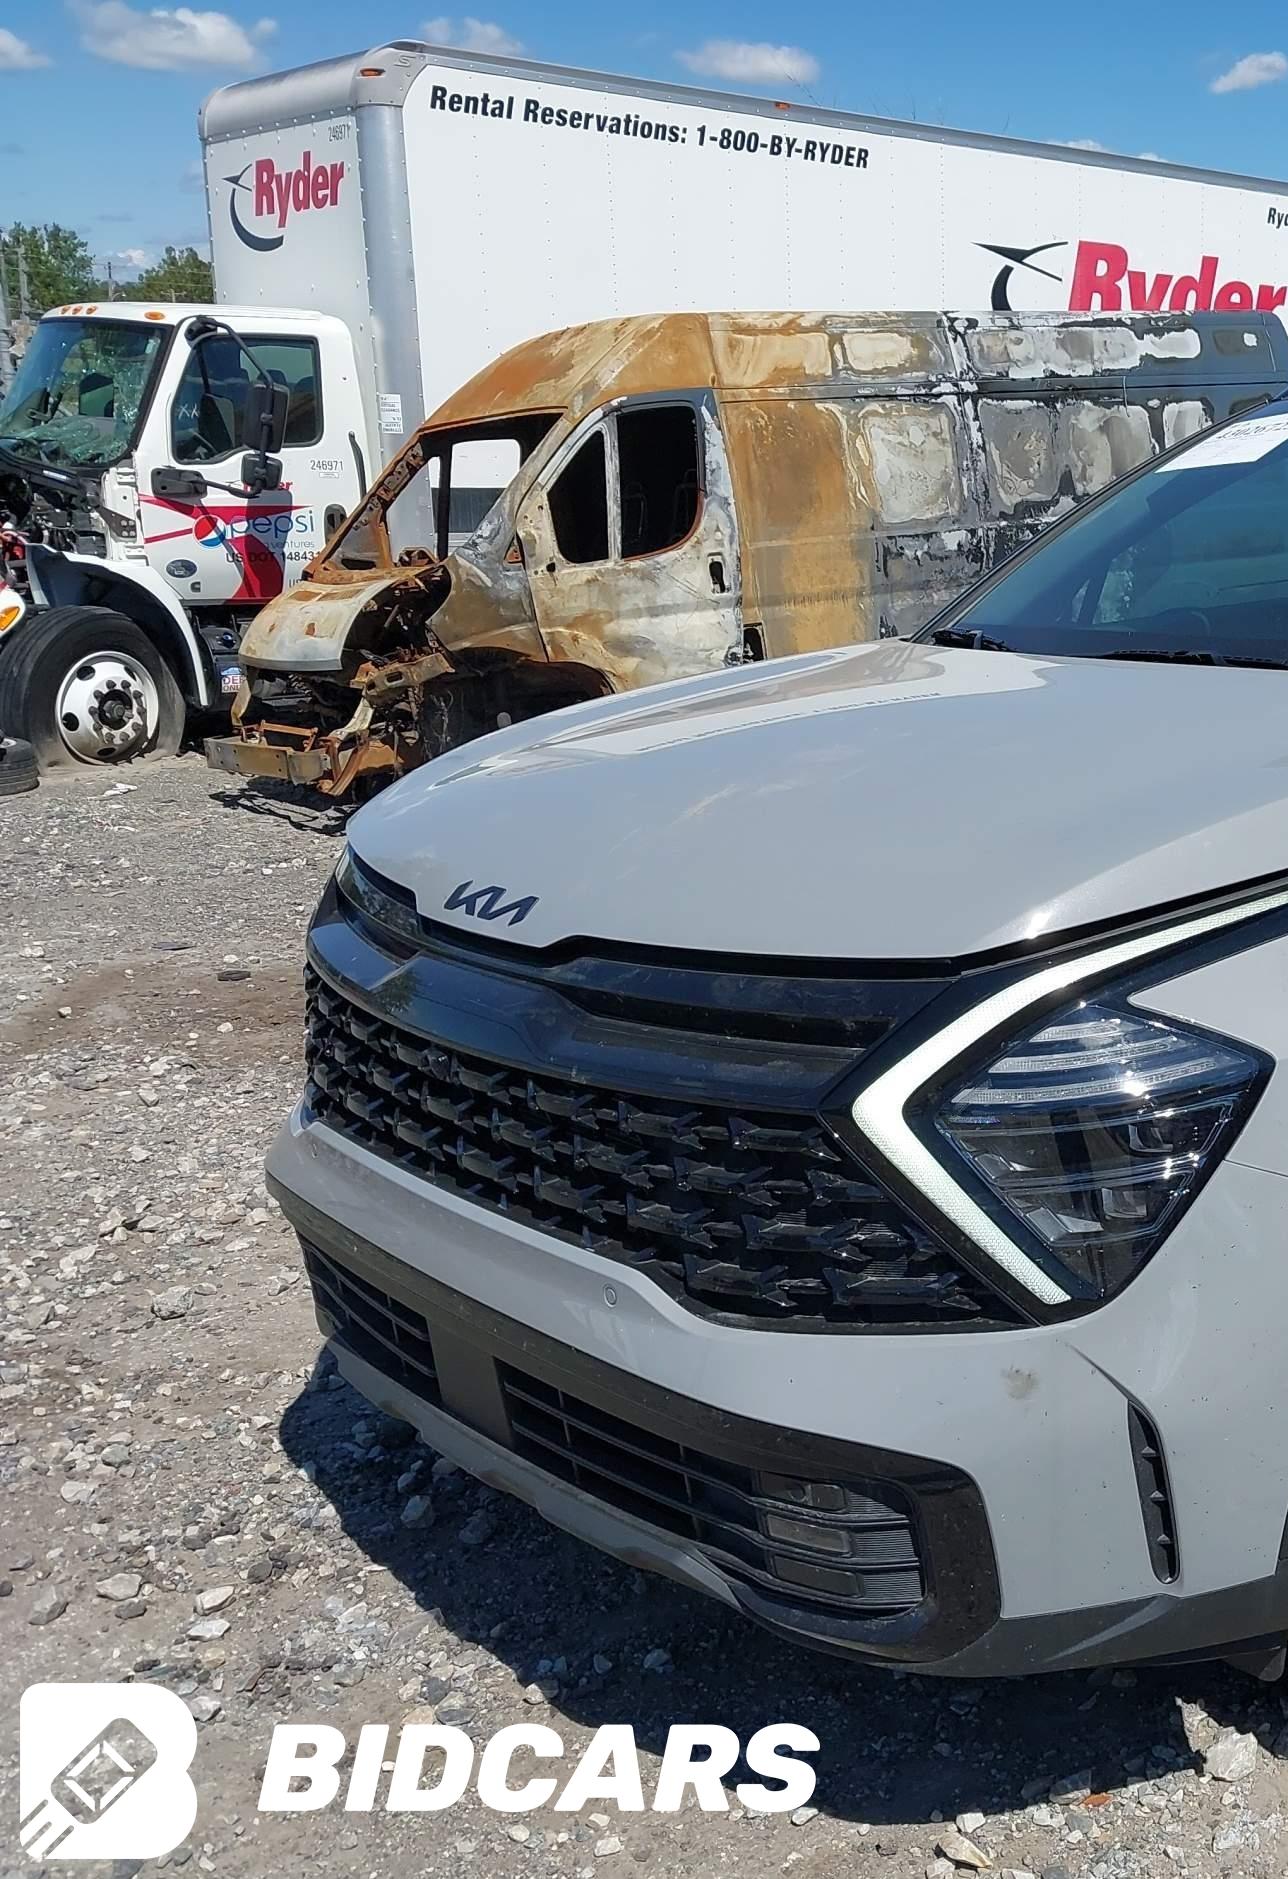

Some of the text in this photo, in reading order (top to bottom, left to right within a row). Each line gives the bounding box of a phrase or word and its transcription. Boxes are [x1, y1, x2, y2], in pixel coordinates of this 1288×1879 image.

[429, 85, 870, 169] Rental Reservations: 1-800-BY-RYDER
[255, 150, 345, 229] Ryder
[310, 459, 344, 471] 246971
[229, 509, 315, 541] pepsi
